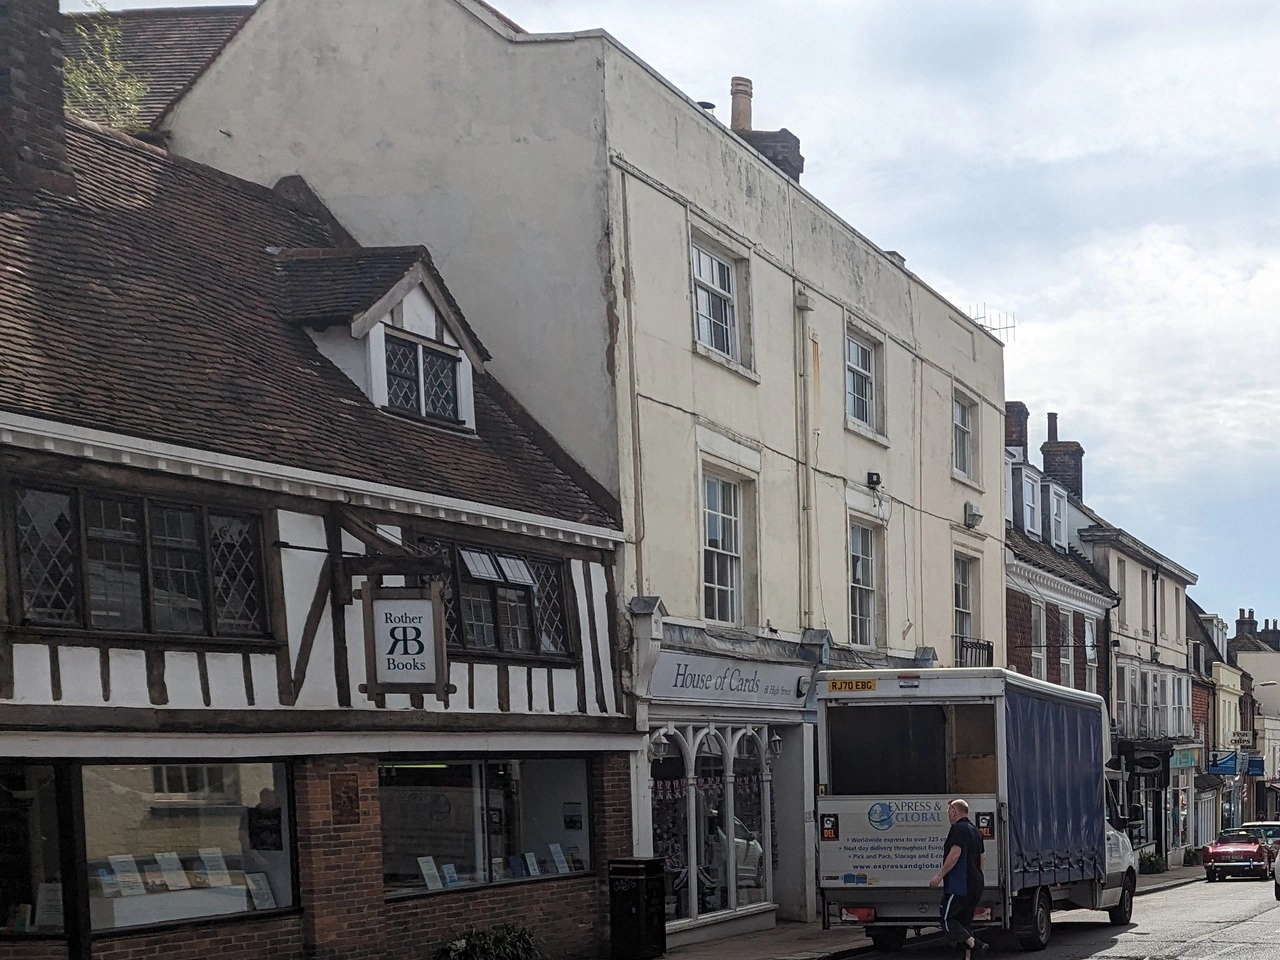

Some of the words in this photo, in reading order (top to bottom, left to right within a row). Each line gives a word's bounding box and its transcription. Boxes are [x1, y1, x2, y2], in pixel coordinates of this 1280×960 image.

[384, 612, 424, 624] Rother
[386, 657, 426, 671] Books
[672, 663, 713, 690] House
[714, 667, 730, 691] of
[729, 668, 761, 694] Cards
[831, 681, 854, 690] RJ70
[855, 681, 872, 690] EBG
[888, 801, 932, 812] EXPRESS
[933, 801, 942, 812] &
[895, 812, 942, 822] GLOBAL
[852, 862, 942, 870] www.expressandglobal
